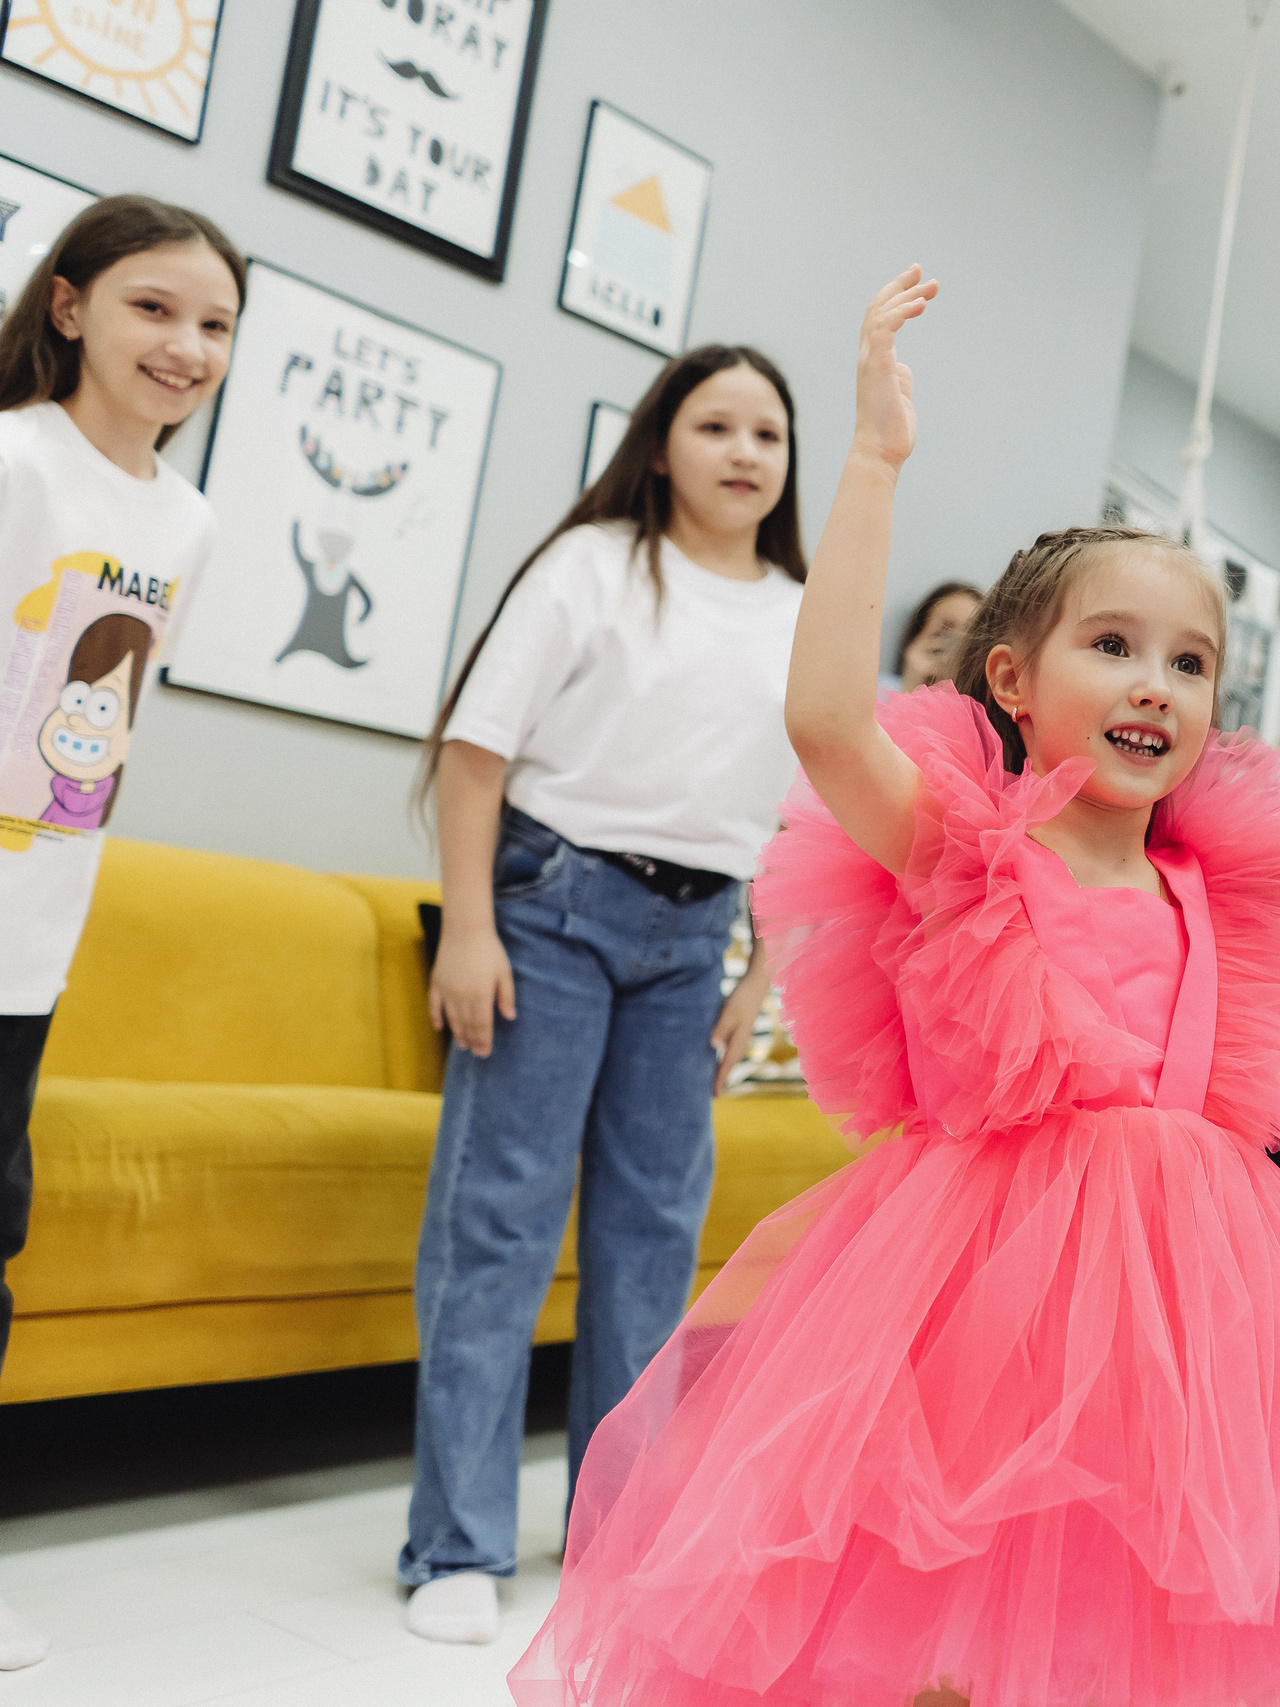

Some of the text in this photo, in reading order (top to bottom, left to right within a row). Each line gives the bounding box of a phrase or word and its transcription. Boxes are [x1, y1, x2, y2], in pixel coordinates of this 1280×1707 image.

[381, 0, 508, 70] ORAY
[319, 80, 491, 192] IT'S YOUR
[364, 154, 436, 213] DAY
[278, 353, 450, 449] PARTY
